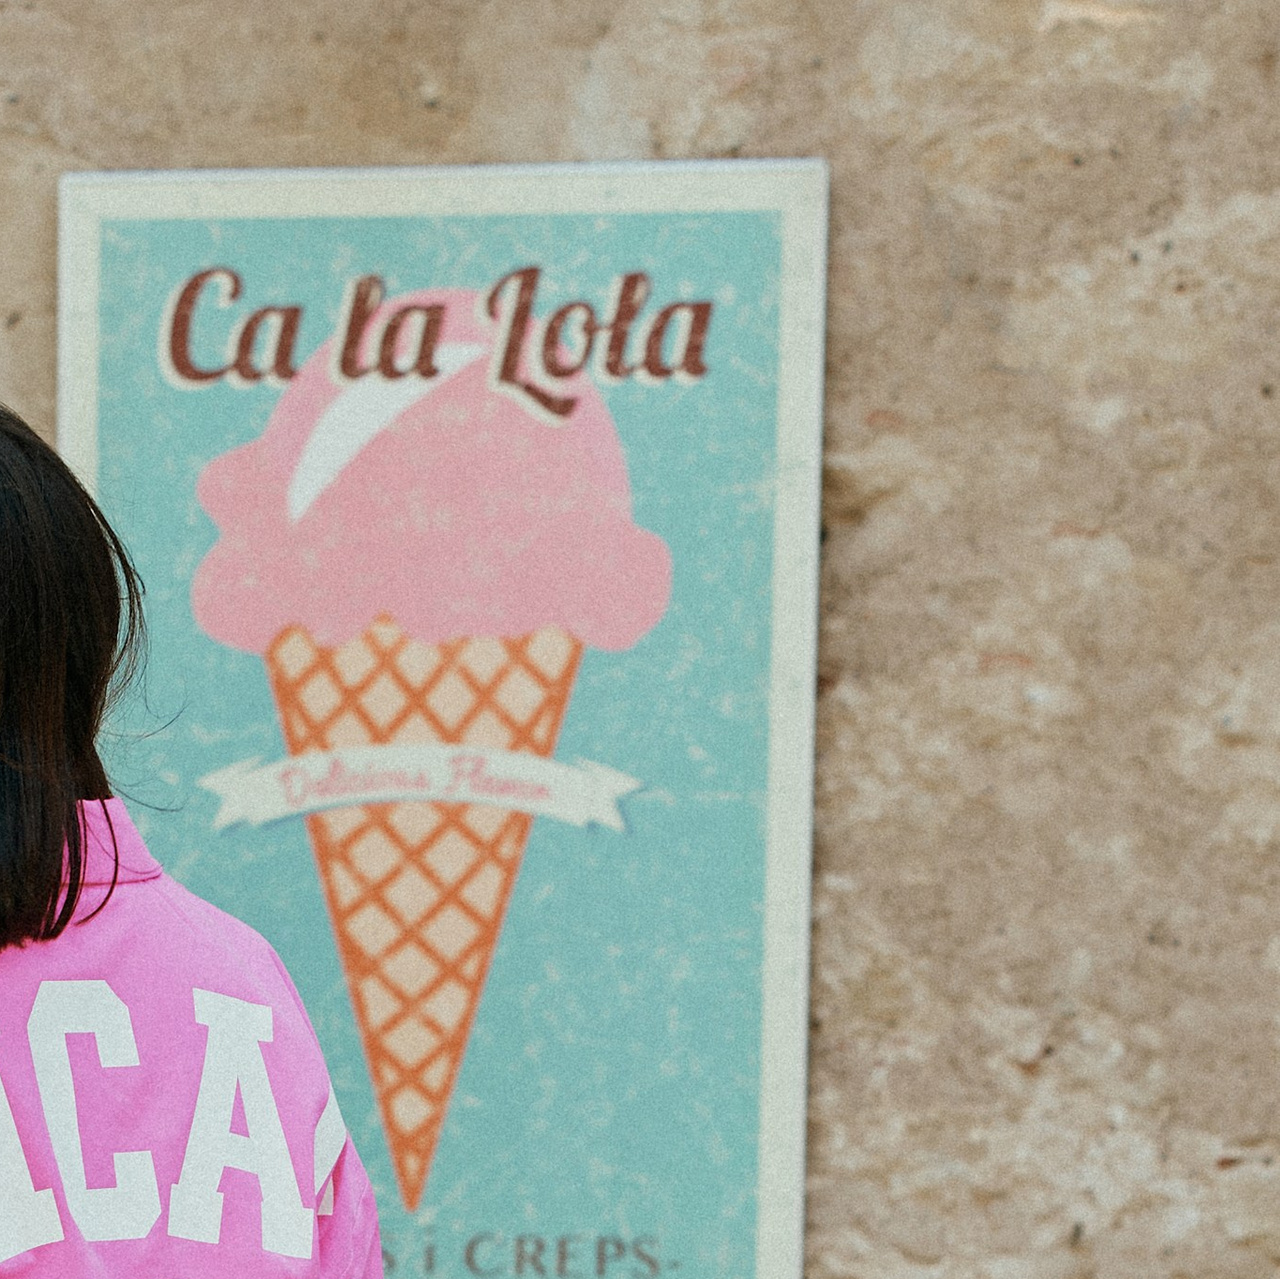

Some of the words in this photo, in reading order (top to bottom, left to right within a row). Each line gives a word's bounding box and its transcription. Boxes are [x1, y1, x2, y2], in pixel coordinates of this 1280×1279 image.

[165, 264, 304, 386] Ca
[334, 272, 447, 382] la
[485, 264, 714, 418] Lola
